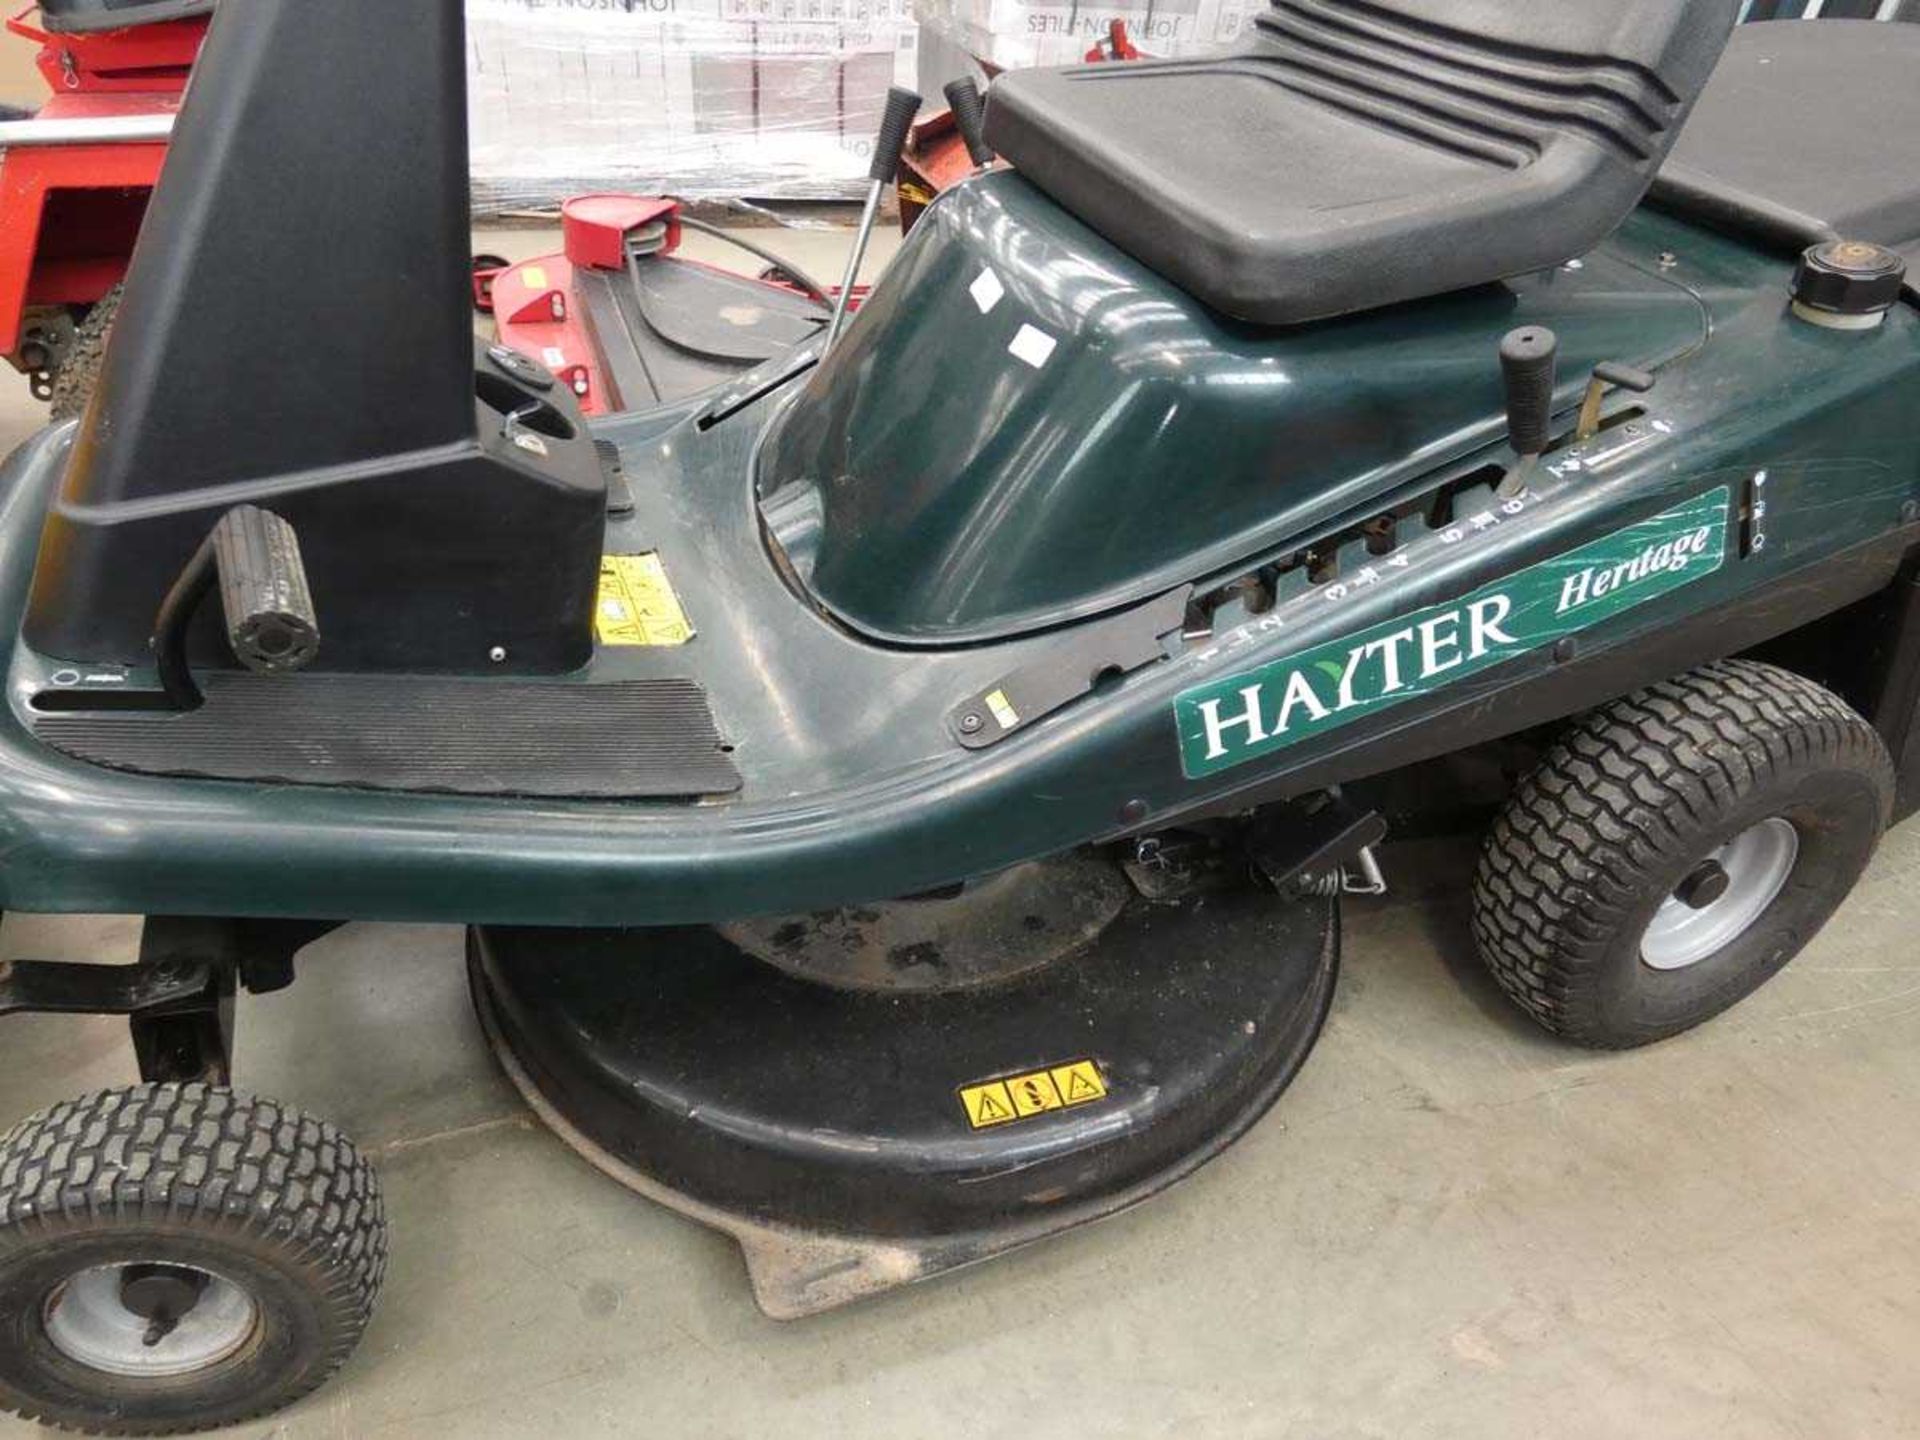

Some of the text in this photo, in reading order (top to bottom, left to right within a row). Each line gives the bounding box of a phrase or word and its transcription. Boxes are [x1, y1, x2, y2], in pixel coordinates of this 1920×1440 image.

[1439, 527, 1464, 544] 5
[1325, 583, 1348, 600] 3
[1260, 614, 1285, 631] 2
[1198, 526, 1711, 760] HAYTER Heritage
